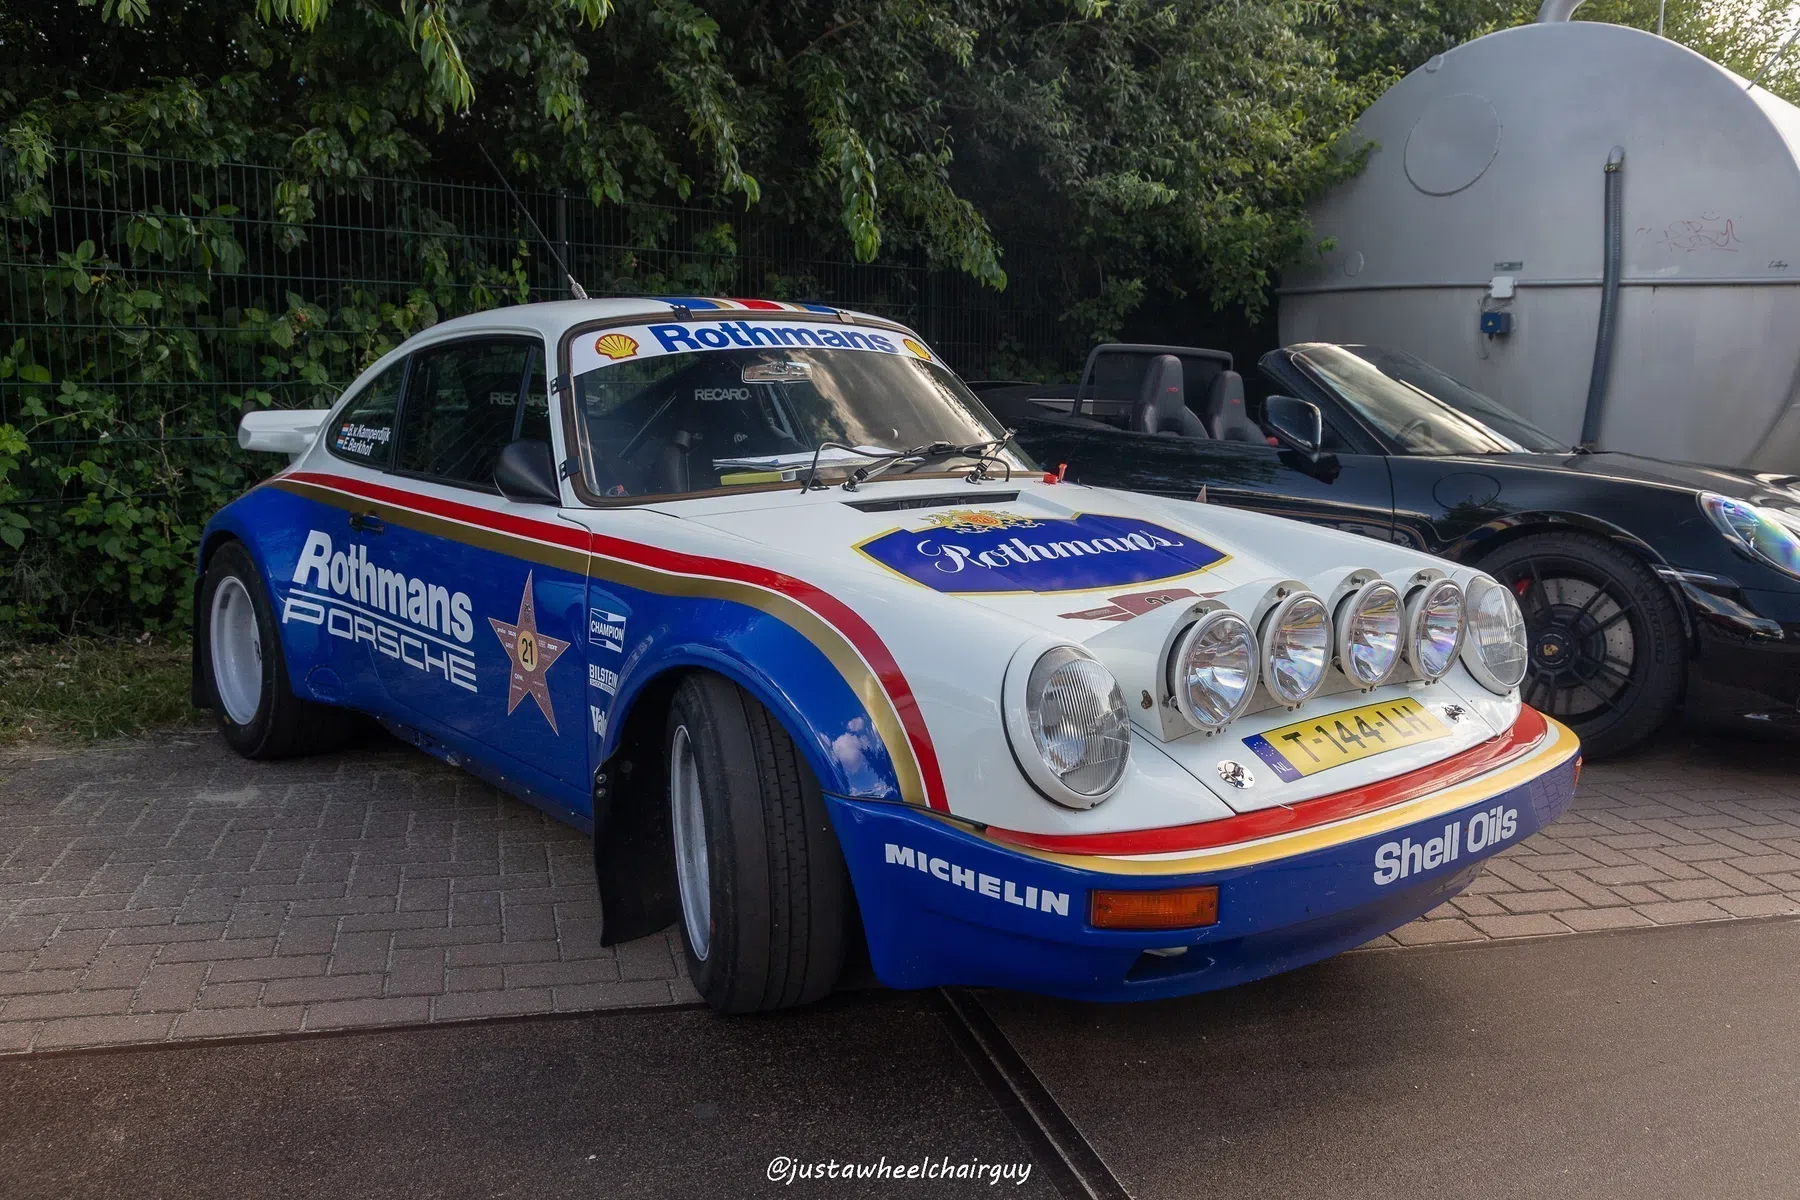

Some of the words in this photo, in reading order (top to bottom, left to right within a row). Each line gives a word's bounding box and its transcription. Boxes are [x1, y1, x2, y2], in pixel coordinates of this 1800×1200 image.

[647, 321, 901, 354] Rothmans
[694, 388, 750, 401] RECARO
[292, 529, 474, 643] Rothmans
[282, 597, 478, 693] PORSCHE
[590, 620, 625, 642] CHAMPION
[521, 637, 535, 665] 21
[589, 663, 619, 689] BILSTEIN
[1281, 705, 1432, 763] T-144-LH
[1271, 760, 1293, 775] NL
[1373, 821, 1461, 886] Shell
[1467, 804, 1518, 853] Oils
[884, 843, 1070, 917] MICHELIN
